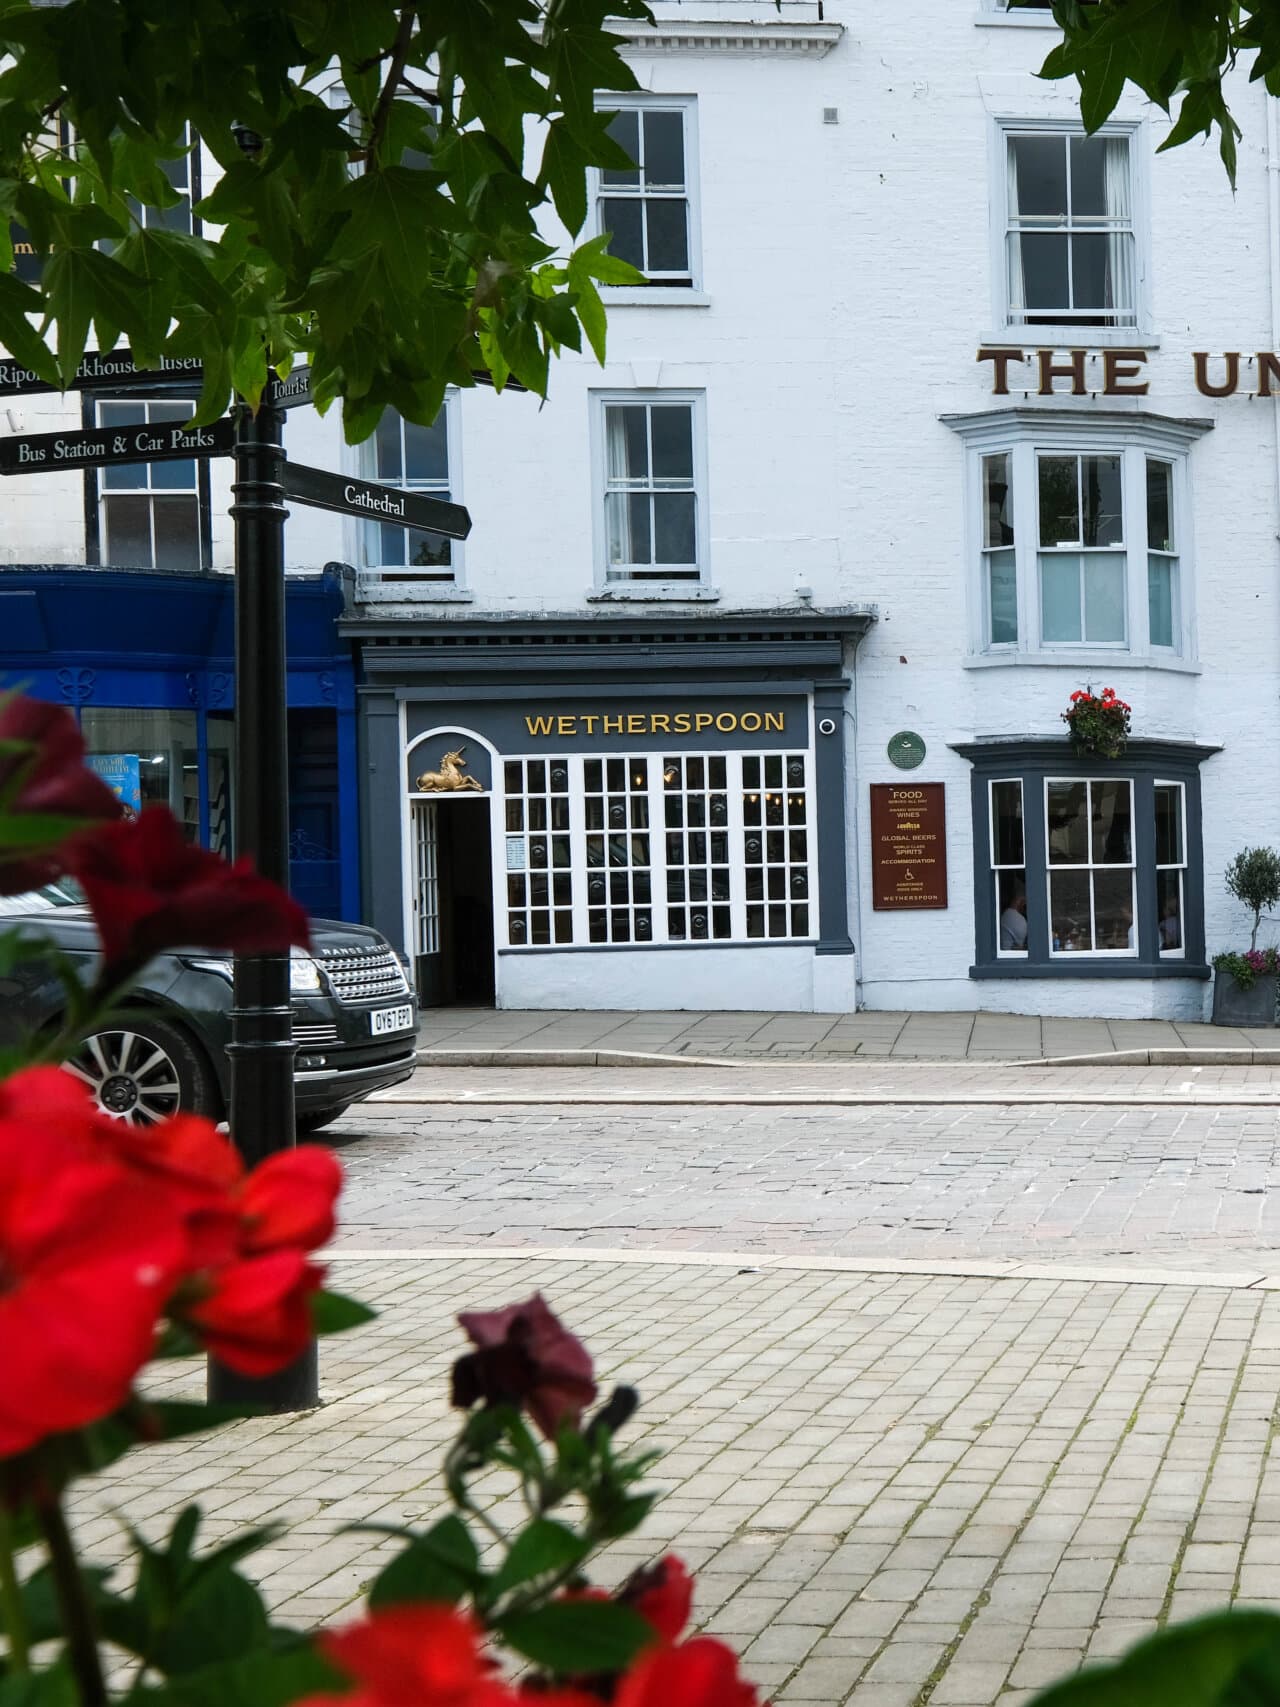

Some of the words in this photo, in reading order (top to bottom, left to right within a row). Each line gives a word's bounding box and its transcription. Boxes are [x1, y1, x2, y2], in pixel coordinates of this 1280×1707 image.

[148, 354, 203, 373] useu
[976, 349, 1149, 396] THE
[271, 377, 310, 400] Tourist
[19, 443, 46, 463] Bus
[53, 440, 105, 459] Station
[113, 436, 127, 454] &
[135, 432, 164, 452] Car
[171, 429, 215, 449] Parks
[344, 485, 405, 517] Cathedral
[524, 712, 785, 736] WETHERSPOON
[893, 791, 923, 799] FOOD
[881, 834, 911, 842] GLOBAL
[322, 947, 363, 956] RANGE
